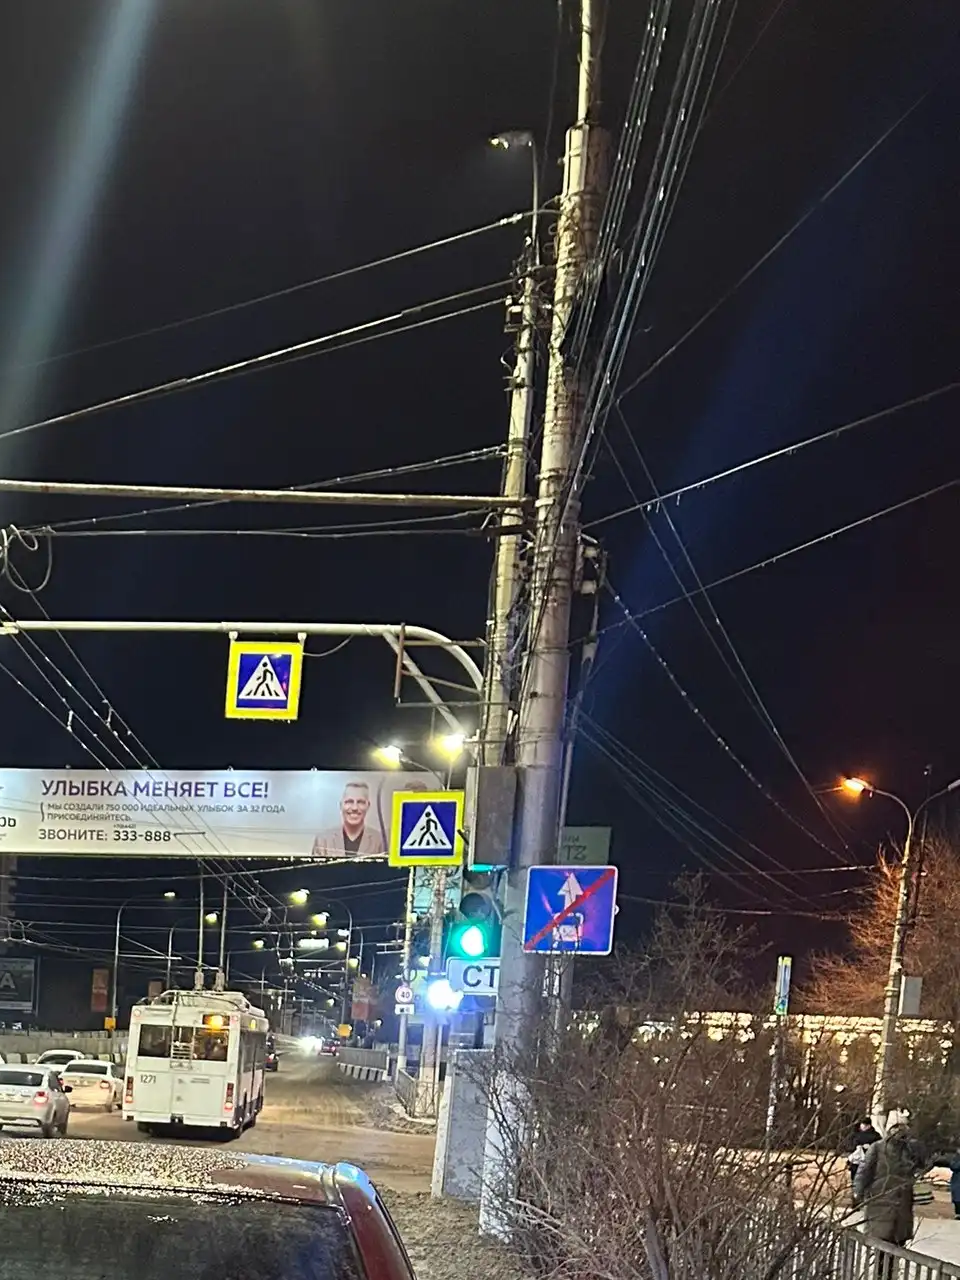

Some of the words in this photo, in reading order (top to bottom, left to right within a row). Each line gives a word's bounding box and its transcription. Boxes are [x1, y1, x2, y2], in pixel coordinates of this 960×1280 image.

[41, 780, 127, 796] УЛЫБКА
[133, 781, 218, 797] МЕНЯЕТ
[224, 782, 269, 798] ВСЕ!
[47, 803, 61, 811] МЫ
[63, 803, 104, 812] СОЗДАЛИ
[140, 804, 194, 813] ИДЕАЛЬНЫХ
[197, 804, 234, 813] УЛЫБОК
[237, 805, 248, 813] ЗА
[250, 805, 260, 813] 32
[262, 805, 286, 814] ГОДА
[39, 829, 108, 841] ЗВОНИТЕ:
[113, 830, 171, 842] 333-888
[401, 991, 411, 999] 40
[140, 1074, 156, 1084] 1271
